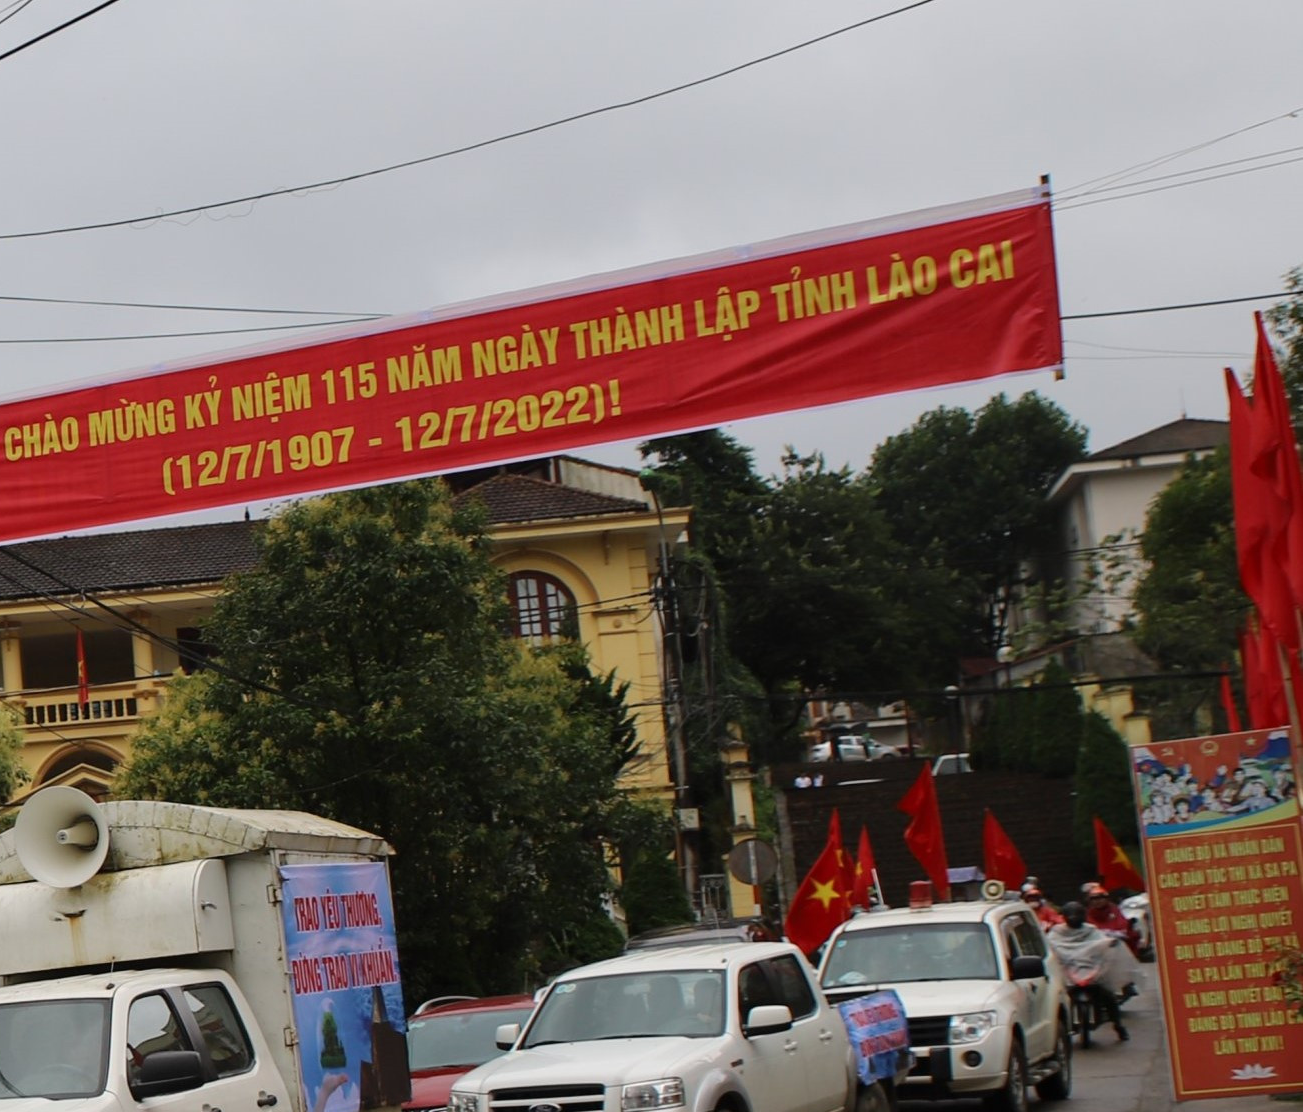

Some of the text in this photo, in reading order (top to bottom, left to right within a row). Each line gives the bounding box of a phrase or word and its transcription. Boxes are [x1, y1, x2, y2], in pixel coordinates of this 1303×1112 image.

[4, 413, 80, 462] CHÀO
[88, 398, 176, 447] MỪNG
[184, 375, 223, 430] KỶ
[231, 371, 313, 422] NIỆM
[320, 362, 379, 406] 115
[386, 344, 464, 394] NĂM
[471, 325, 560, 379] NGÀY
[570, 305, 686, 360] THÀNH
[695, 286, 761, 342] LẬP
[771, 266, 857, 323] TỈNH
[866, 252, 938, 305] LÀO
[949, 239, 1015, 289] CAI
[162, 379, 623, 496] (12/7/1907 - 12/7/2022)!
[1263, 862, 1281, 878] SA
[1281, 861, 1298, 876] PA
[294, 896, 321, 932] TRAO
[320, 888, 341, 931] YÊU
[292, 951, 323, 995] ĐỪNG
[322, 955, 349, 991] TRAO
[349, 952, 362, 988] VI
[1187, 968, 1204, 984] SA
[1203, 966, 1220, 982] PA
